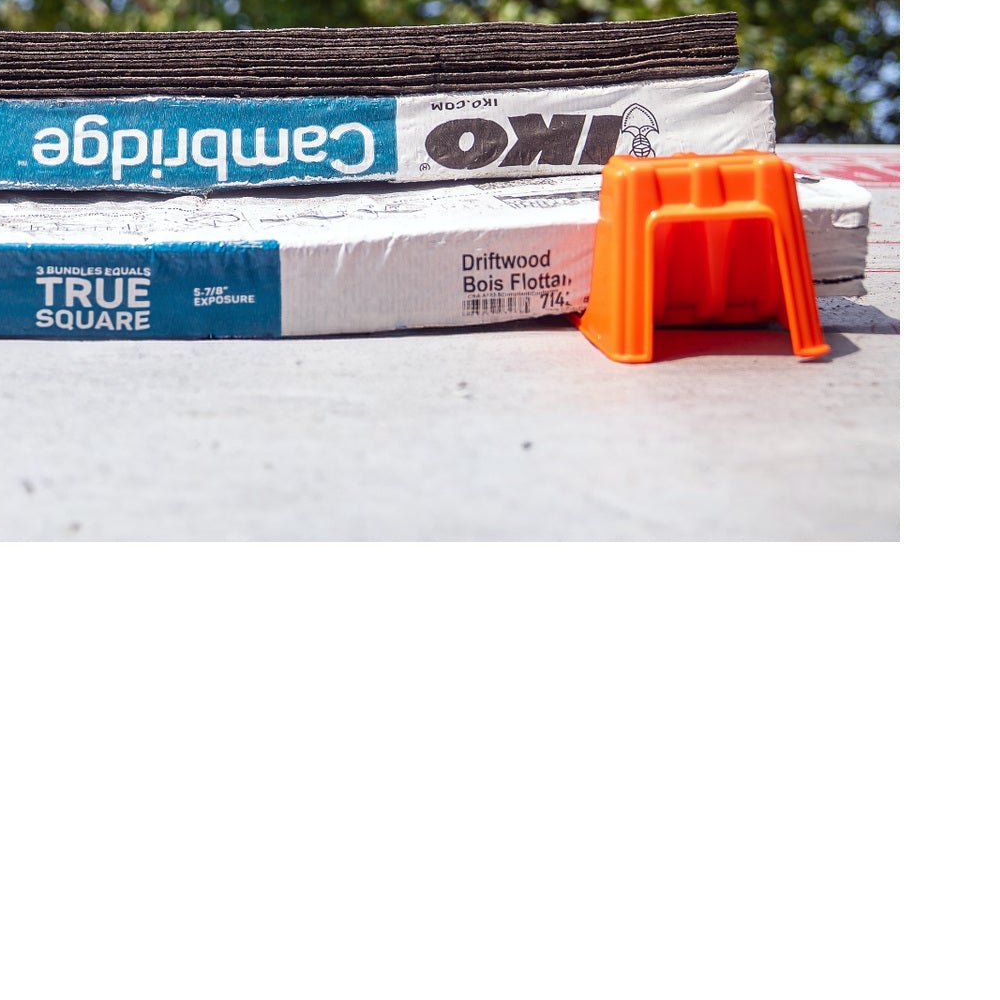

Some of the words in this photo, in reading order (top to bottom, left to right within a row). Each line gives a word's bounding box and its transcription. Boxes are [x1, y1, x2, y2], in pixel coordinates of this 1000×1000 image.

[431, 98, 498, 111] IKO.COM
[31, 114, 375, 181] Cambridge
[424, 113, 623, 170] IKO
[36, 266, 44, 276] 3
[46, 265, 102, 277] BUNDLES
[104, 266, 151, 277] EQUALS
[462, 249, 551, 271] Driftwood
[35, 276, 151, 309] TRUE
[463, 274, 504, 293] Bois
[193, 294, 255, 307] EXPOSURE
[35, 308, 151, 331] SQUARE
